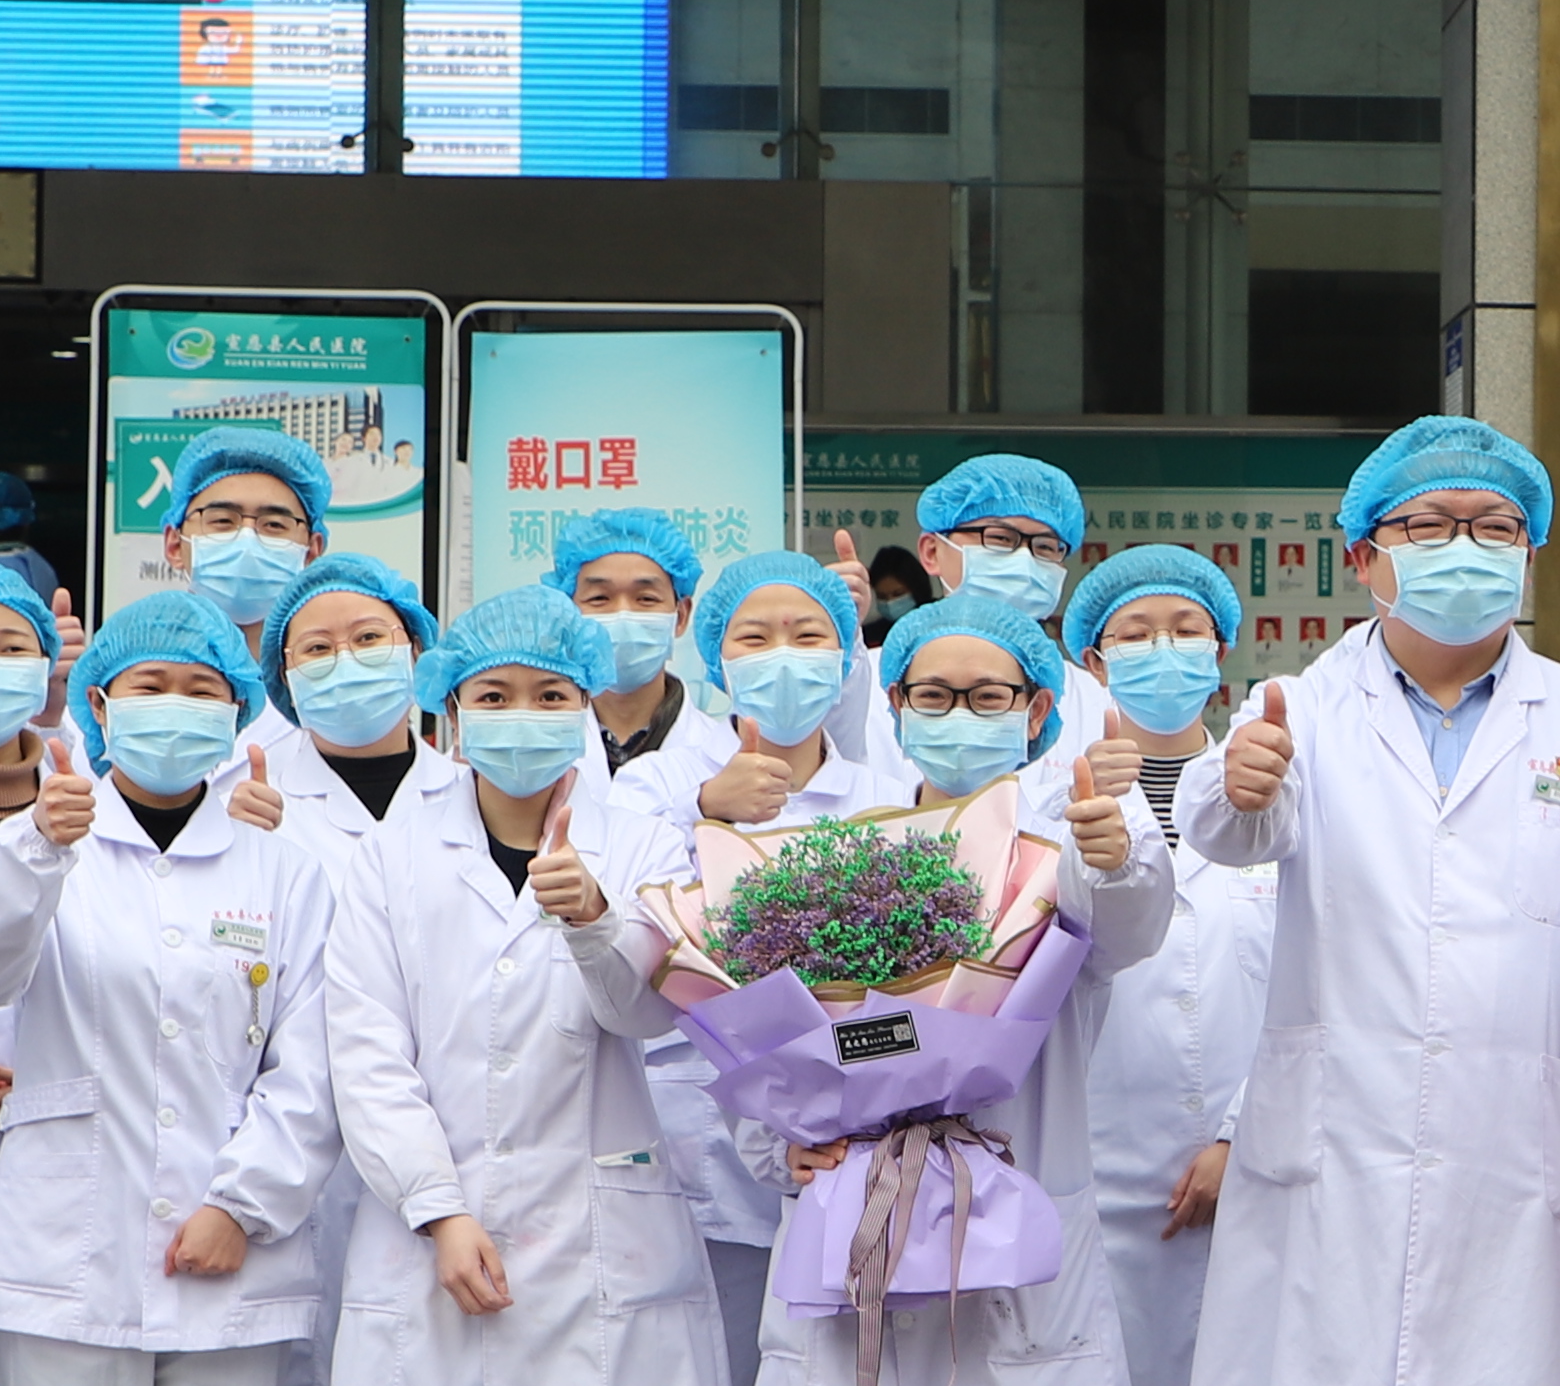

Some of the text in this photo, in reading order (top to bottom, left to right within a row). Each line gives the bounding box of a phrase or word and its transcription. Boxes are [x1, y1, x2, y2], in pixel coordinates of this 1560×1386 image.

[225, 333, 367, 355] 宣恩县人民医院
[508, 437, 638, 491] 戴口罩
